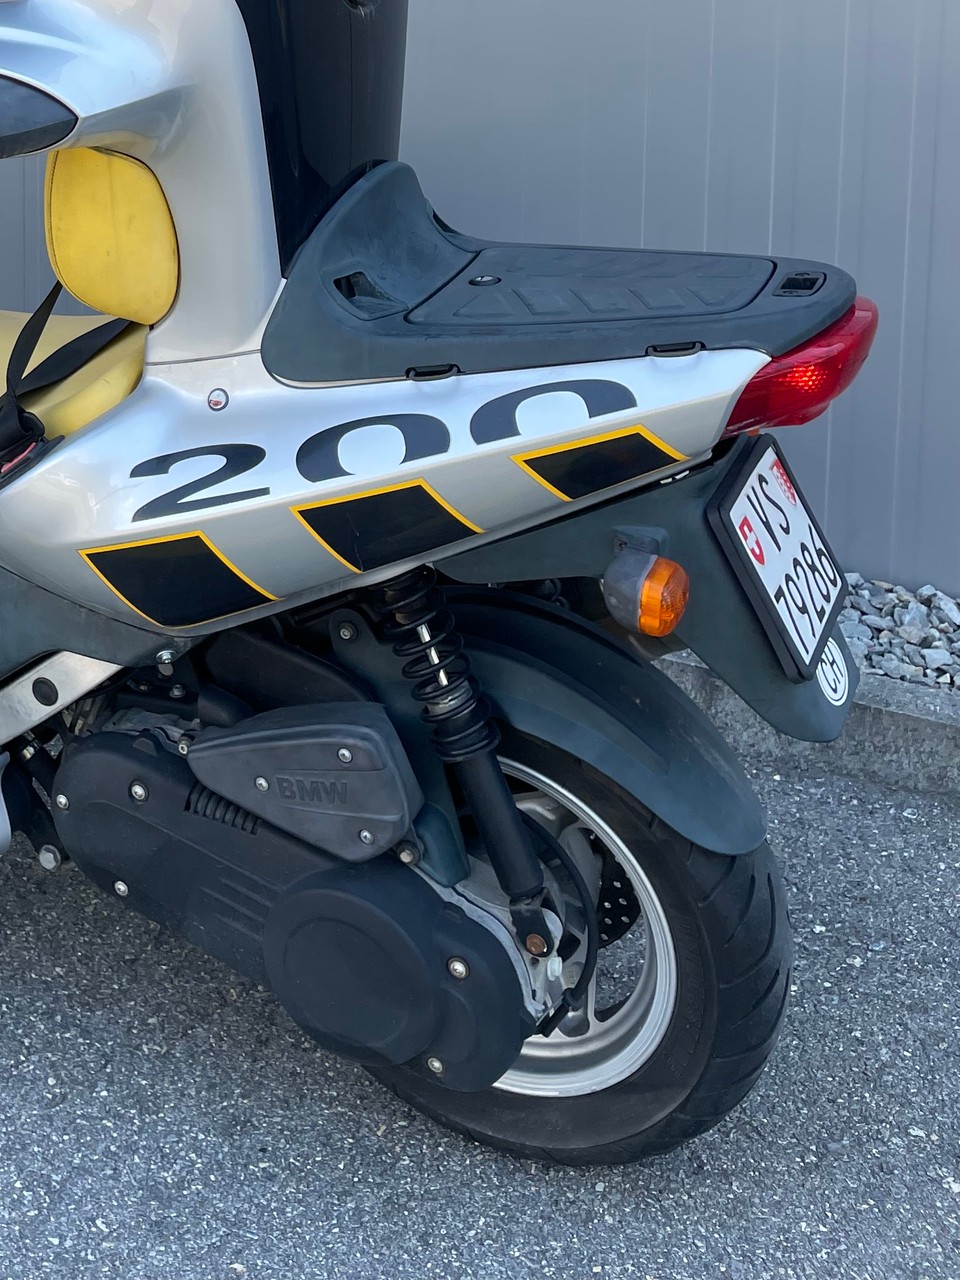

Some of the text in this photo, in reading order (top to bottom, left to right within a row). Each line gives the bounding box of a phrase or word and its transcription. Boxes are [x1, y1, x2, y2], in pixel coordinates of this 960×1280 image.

[129, 378, 638, 523] 200
[746, 472, 790, 552] VS
[774, 524, 839, 655] 79286
[276, 777, 348, 805] BMW
